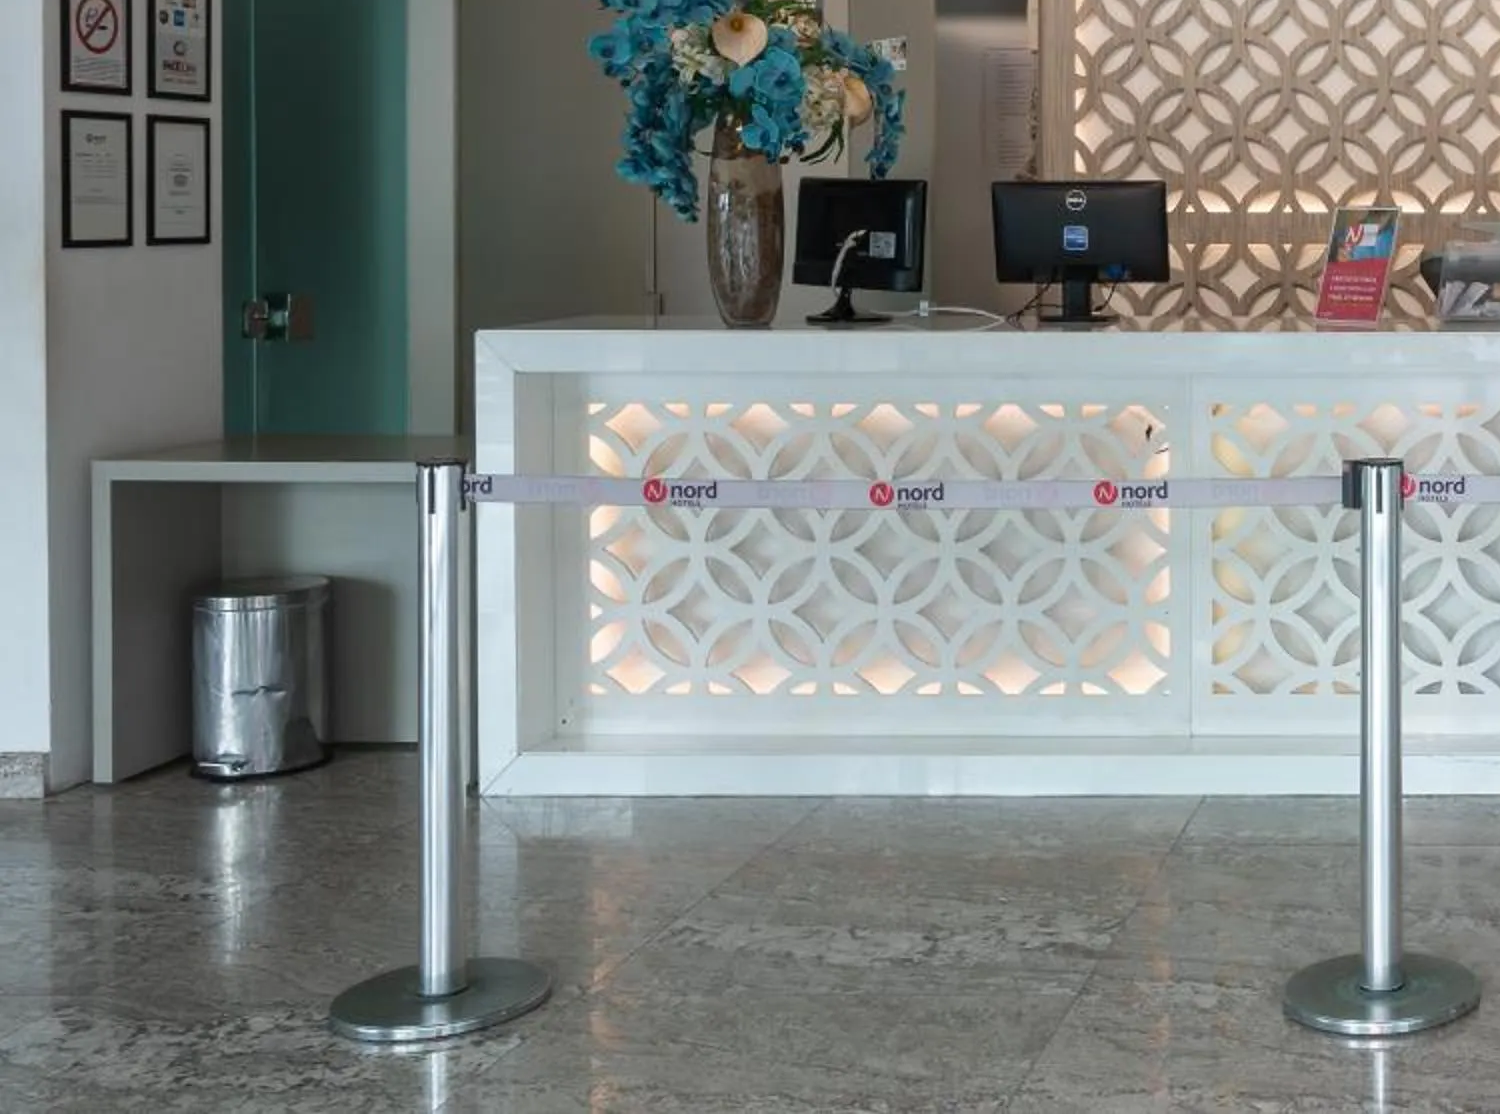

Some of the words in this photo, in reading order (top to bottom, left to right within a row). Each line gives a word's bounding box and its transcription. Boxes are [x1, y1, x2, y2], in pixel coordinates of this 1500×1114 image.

[671, 481, 717, 498] nord
[897, 482, 944, 500] nord
[1121, 480, 1168, 499] nord
[1419, 475, 1465, 494] nord
